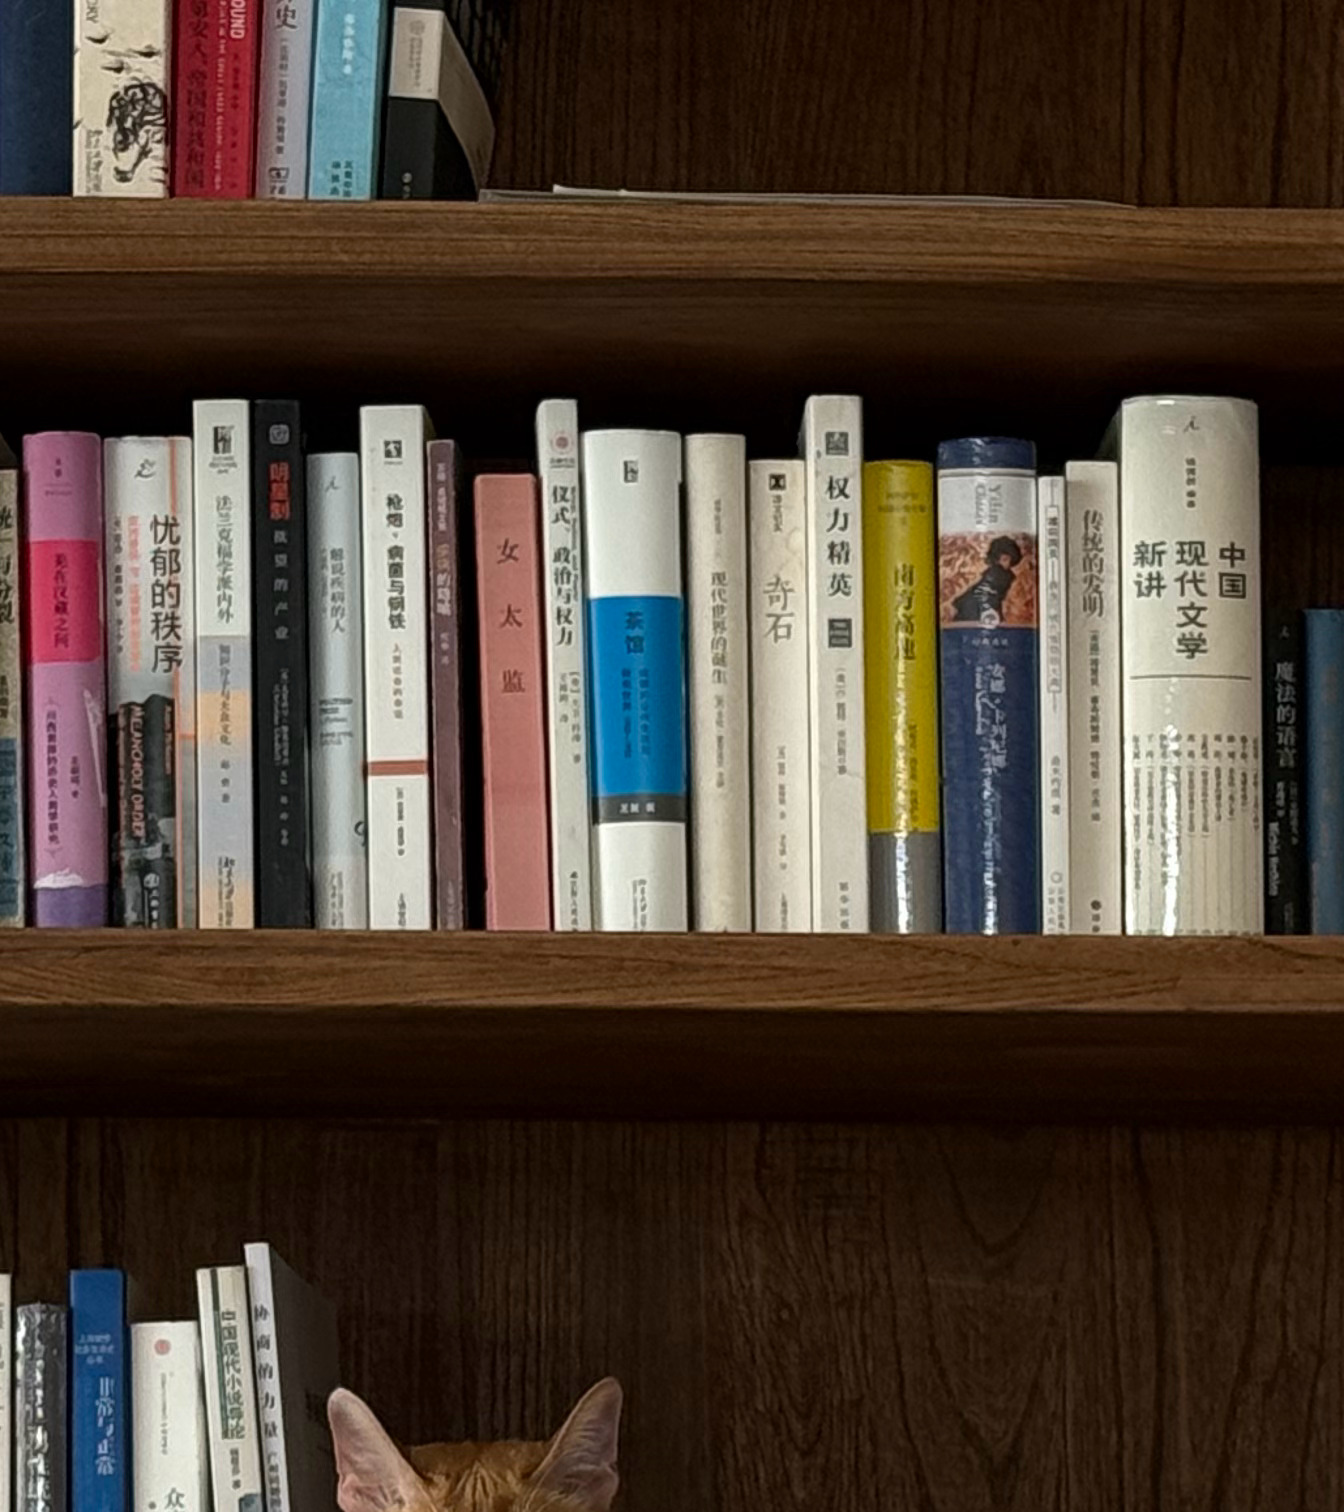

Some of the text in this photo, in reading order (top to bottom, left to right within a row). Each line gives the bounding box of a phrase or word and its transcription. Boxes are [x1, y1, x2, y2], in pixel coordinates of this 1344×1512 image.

[150, 515, 183, 674] 忧郁的秩序
[386, 494, 405, 630] 枪炮、病菌与钢铁
[551, 485, 572, 646] 仪式、政治与权力
[825, 476, 852, 596] 权力精英
[1082, 509, 1103, 617] 传统的发明
[1133, 541, 1167, 598] 新讲
[1219, 541, 1247, 598] 中国
[497, 538, 526, 693] 女太监
[711, 573, 727, 684] 现代世界的诞生
[762, 575, 795, 642] 奇石
[1175, 541, 1207, 658] 现代文学
